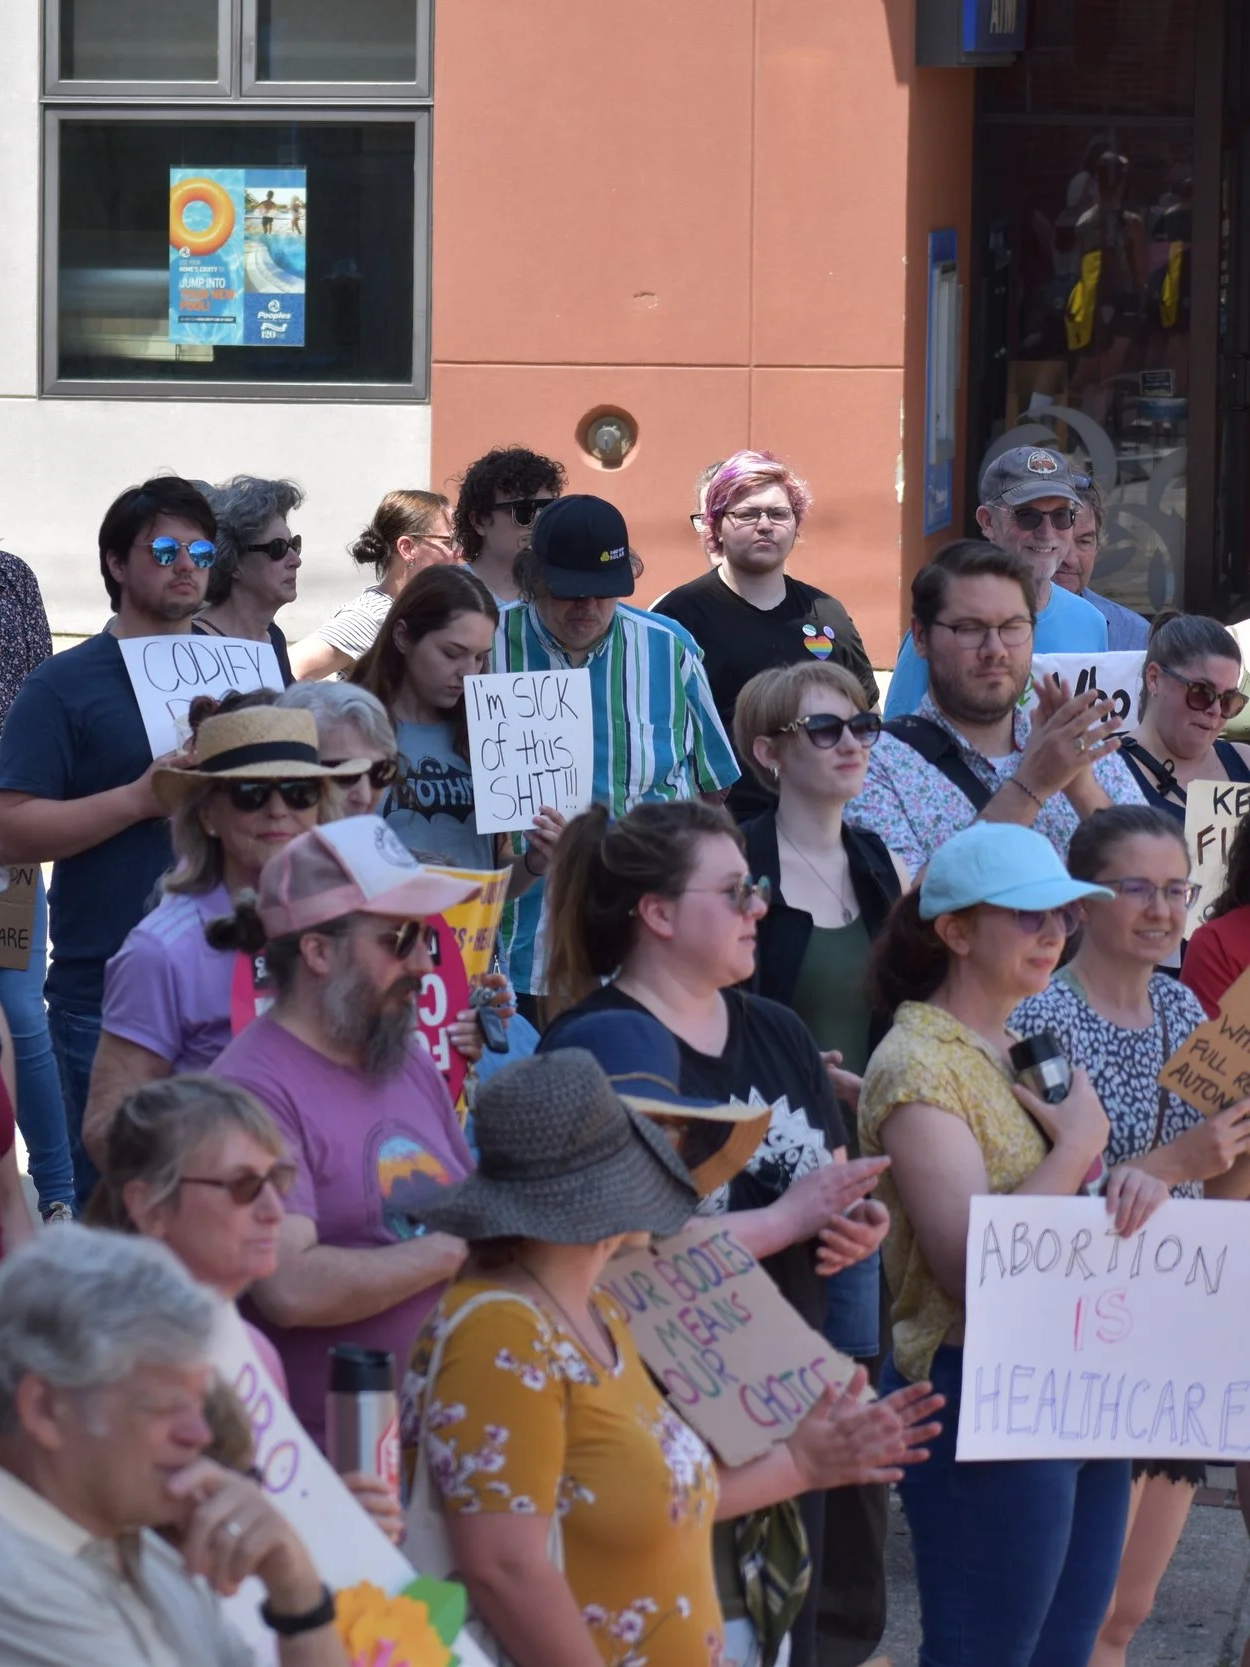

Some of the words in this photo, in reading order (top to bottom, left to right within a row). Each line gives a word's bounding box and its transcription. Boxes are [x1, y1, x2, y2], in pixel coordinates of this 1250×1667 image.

[179, 277, 205, 288] JUMP
[206, 277, 226, 288] INTO
[257, 311, 291, 320] Peoples
[143, 641, 264, 692] CODIFY
[472, 680, 506, 721] I'm
[513, 676, 578, 721] SICK
[481, 721, 510, 771] of
[516, 730, 574, 769] this
[1189, 1037, 1227, 1076] FULL
[652, 1230, 755, 1302] BODIES
[979, 1220, 1228, 1296] ABORTION
[654, 1291, 752, 1358] MEANS
[1073, 1286, 1133, 1352] IS
[663, 1348, 740, 1405] OUR
[973, 1363, 1250, 1453] HEALTHCARE
